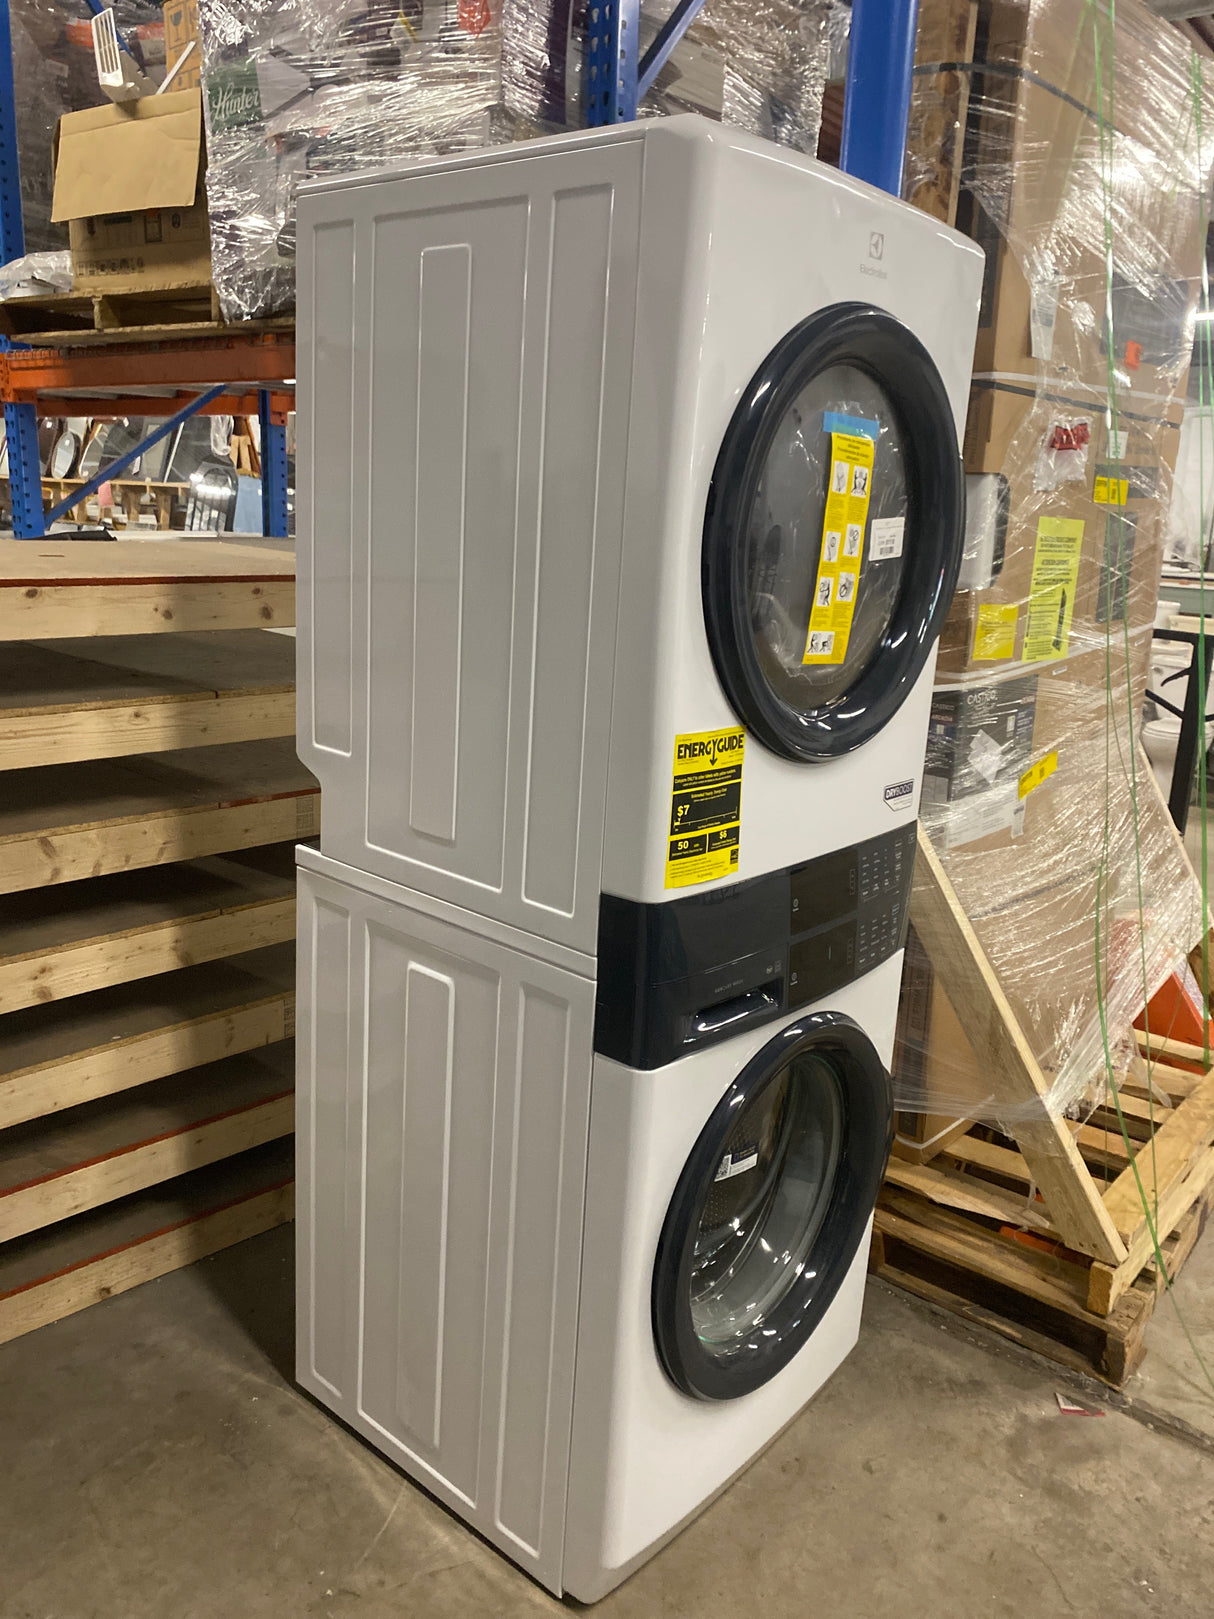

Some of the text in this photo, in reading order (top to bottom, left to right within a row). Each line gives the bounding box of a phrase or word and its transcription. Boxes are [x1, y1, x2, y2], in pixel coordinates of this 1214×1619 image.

[208, 82, 259, 120] Hunter
[677, 733, 745, 763] ENERGYGUIDE
[885, 782, 913, 799] DRYBOOST
[677, 804, 690, 817] $7
[677, 841, 689, 850] 50
